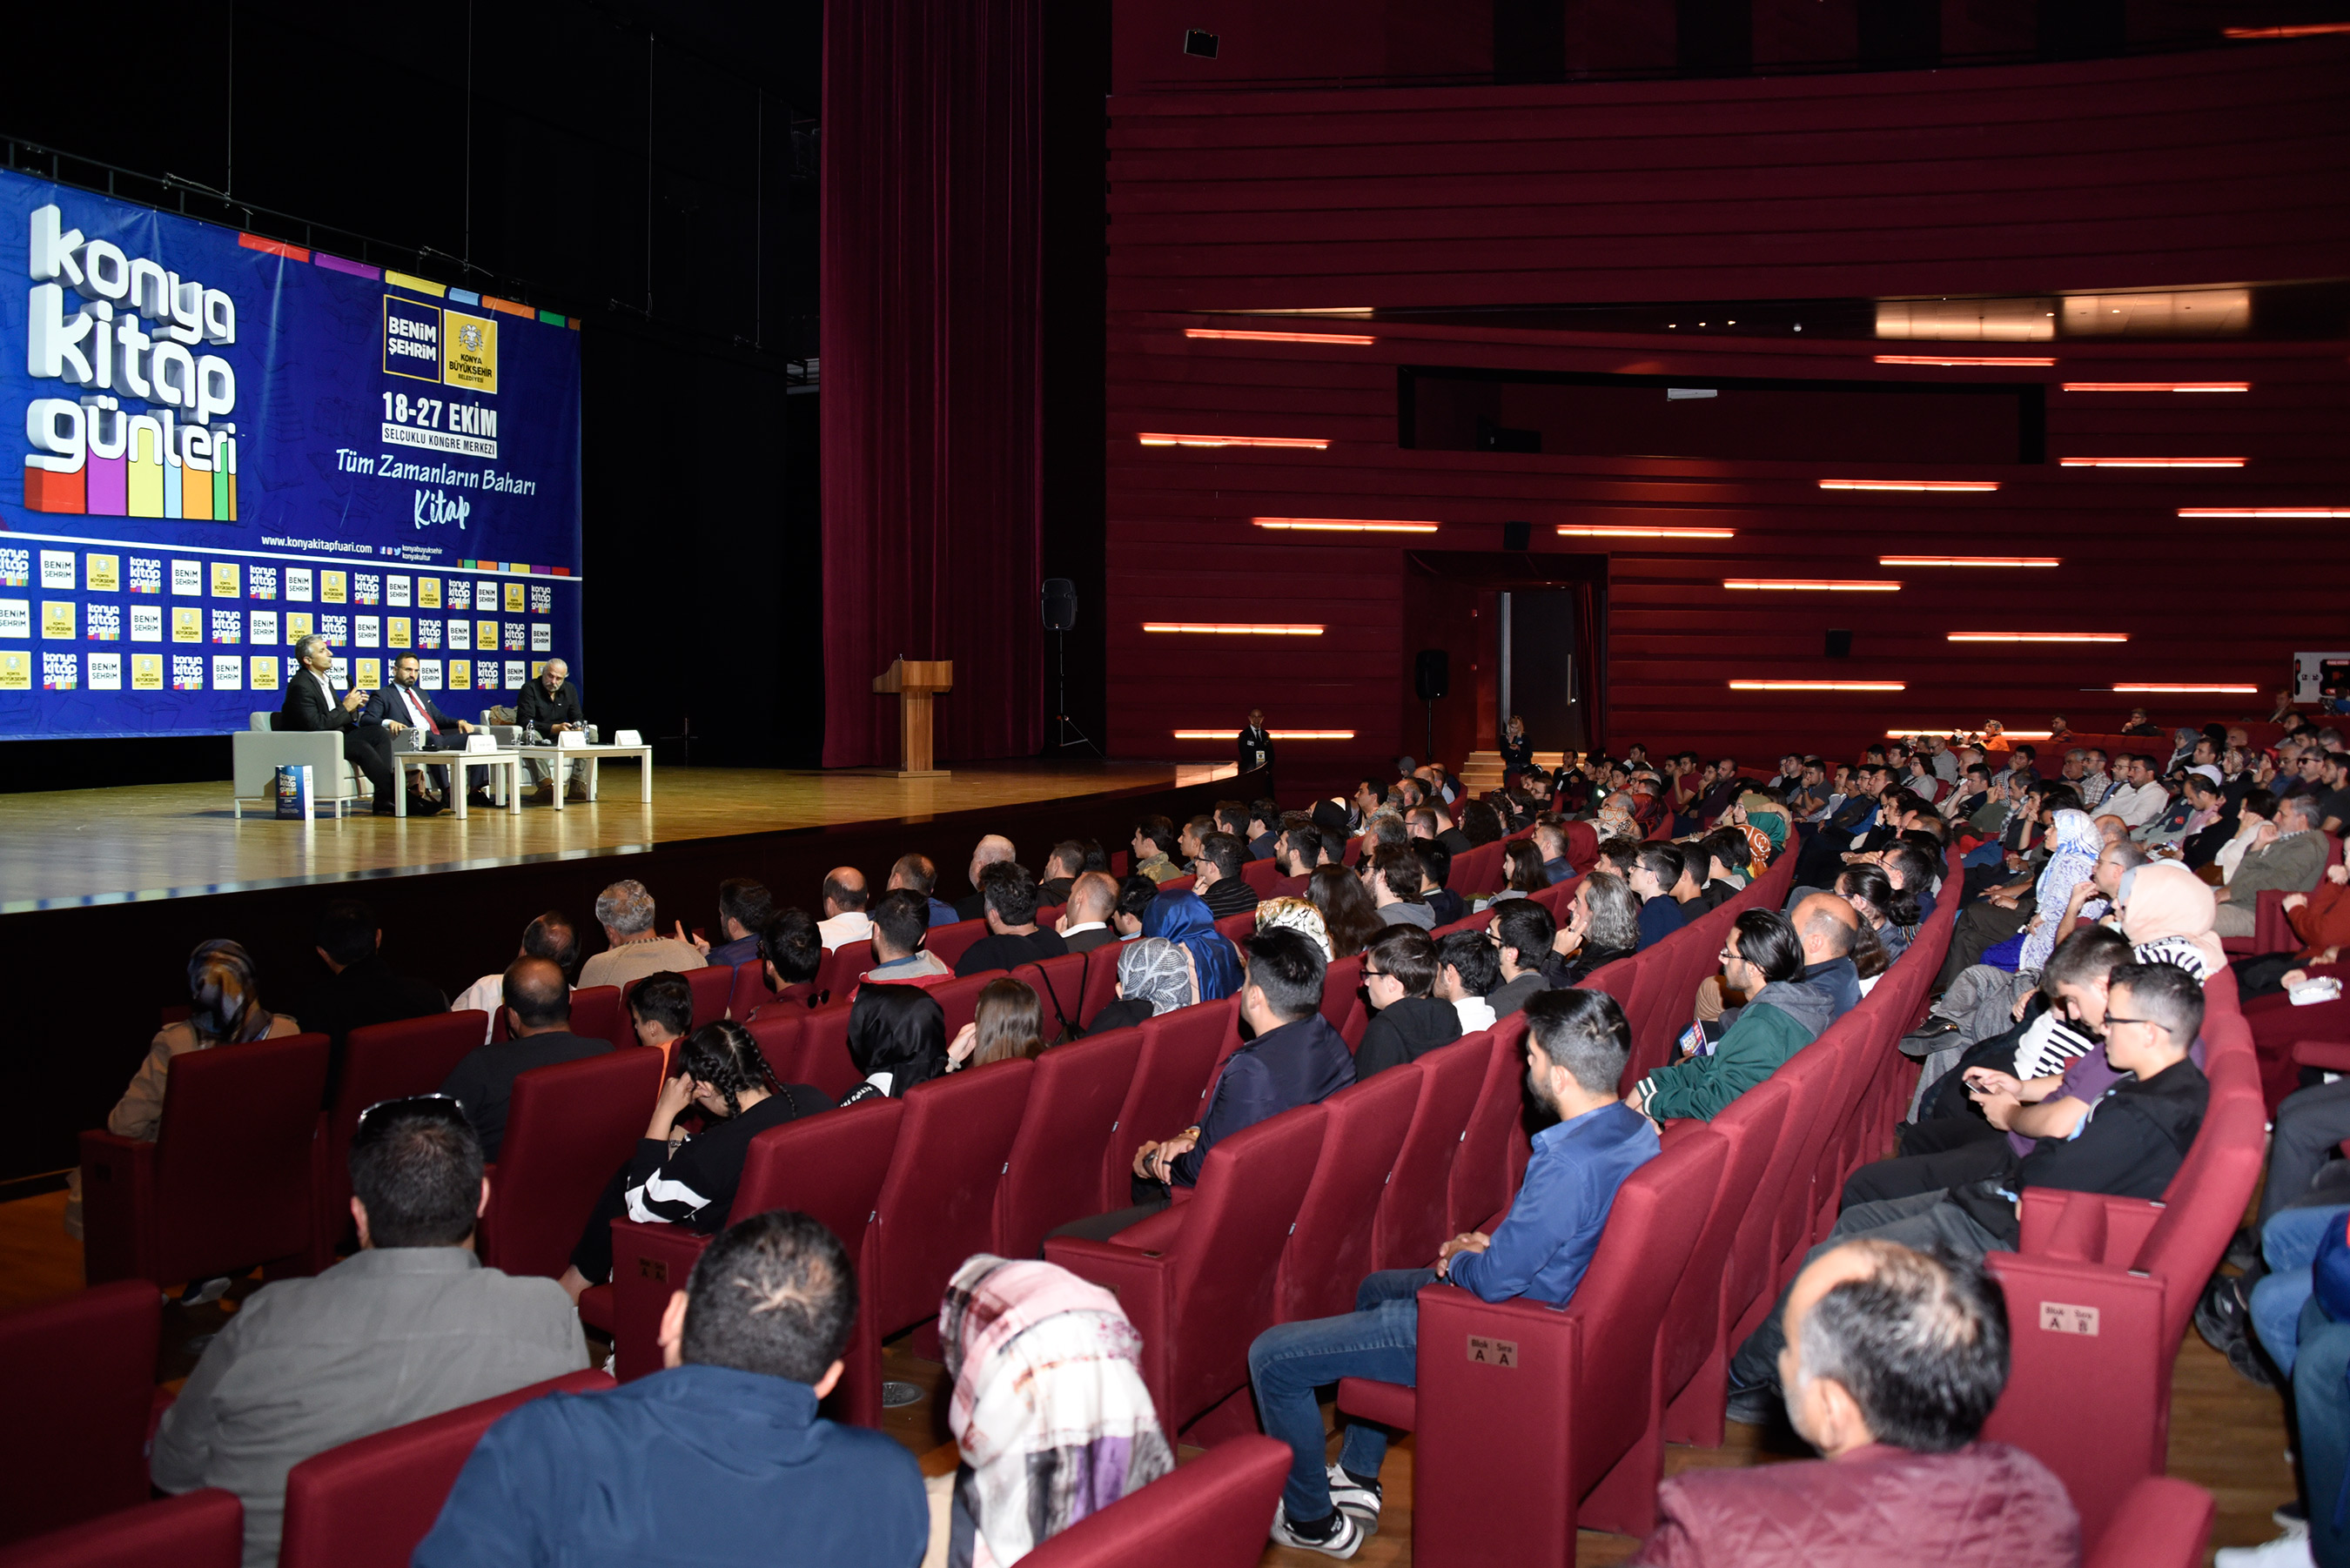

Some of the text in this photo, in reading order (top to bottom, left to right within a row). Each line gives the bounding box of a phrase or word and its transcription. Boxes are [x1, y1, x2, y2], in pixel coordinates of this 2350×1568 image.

[30, 204, 235, 345] konya
[28, 283, 235, 425] kitap
[460, 353, 482, 365] KONYA
[24, 395, 236, 475] günleri
[382, 392, 497, 438] 18-27 EKİM
[384, 427, 495, 455] SELÇUKLU KONGRE MERKEZİ
[336, 448, 535, 496] Tüm Zamanların Baharı
[414, 488, 470, 530] Kitap
[261, 534, 373, 554] www.konyakitapfuari.com
[2049, 1317, 2061, 1330] A
[1475, 1350, 1509, 1366] A A
